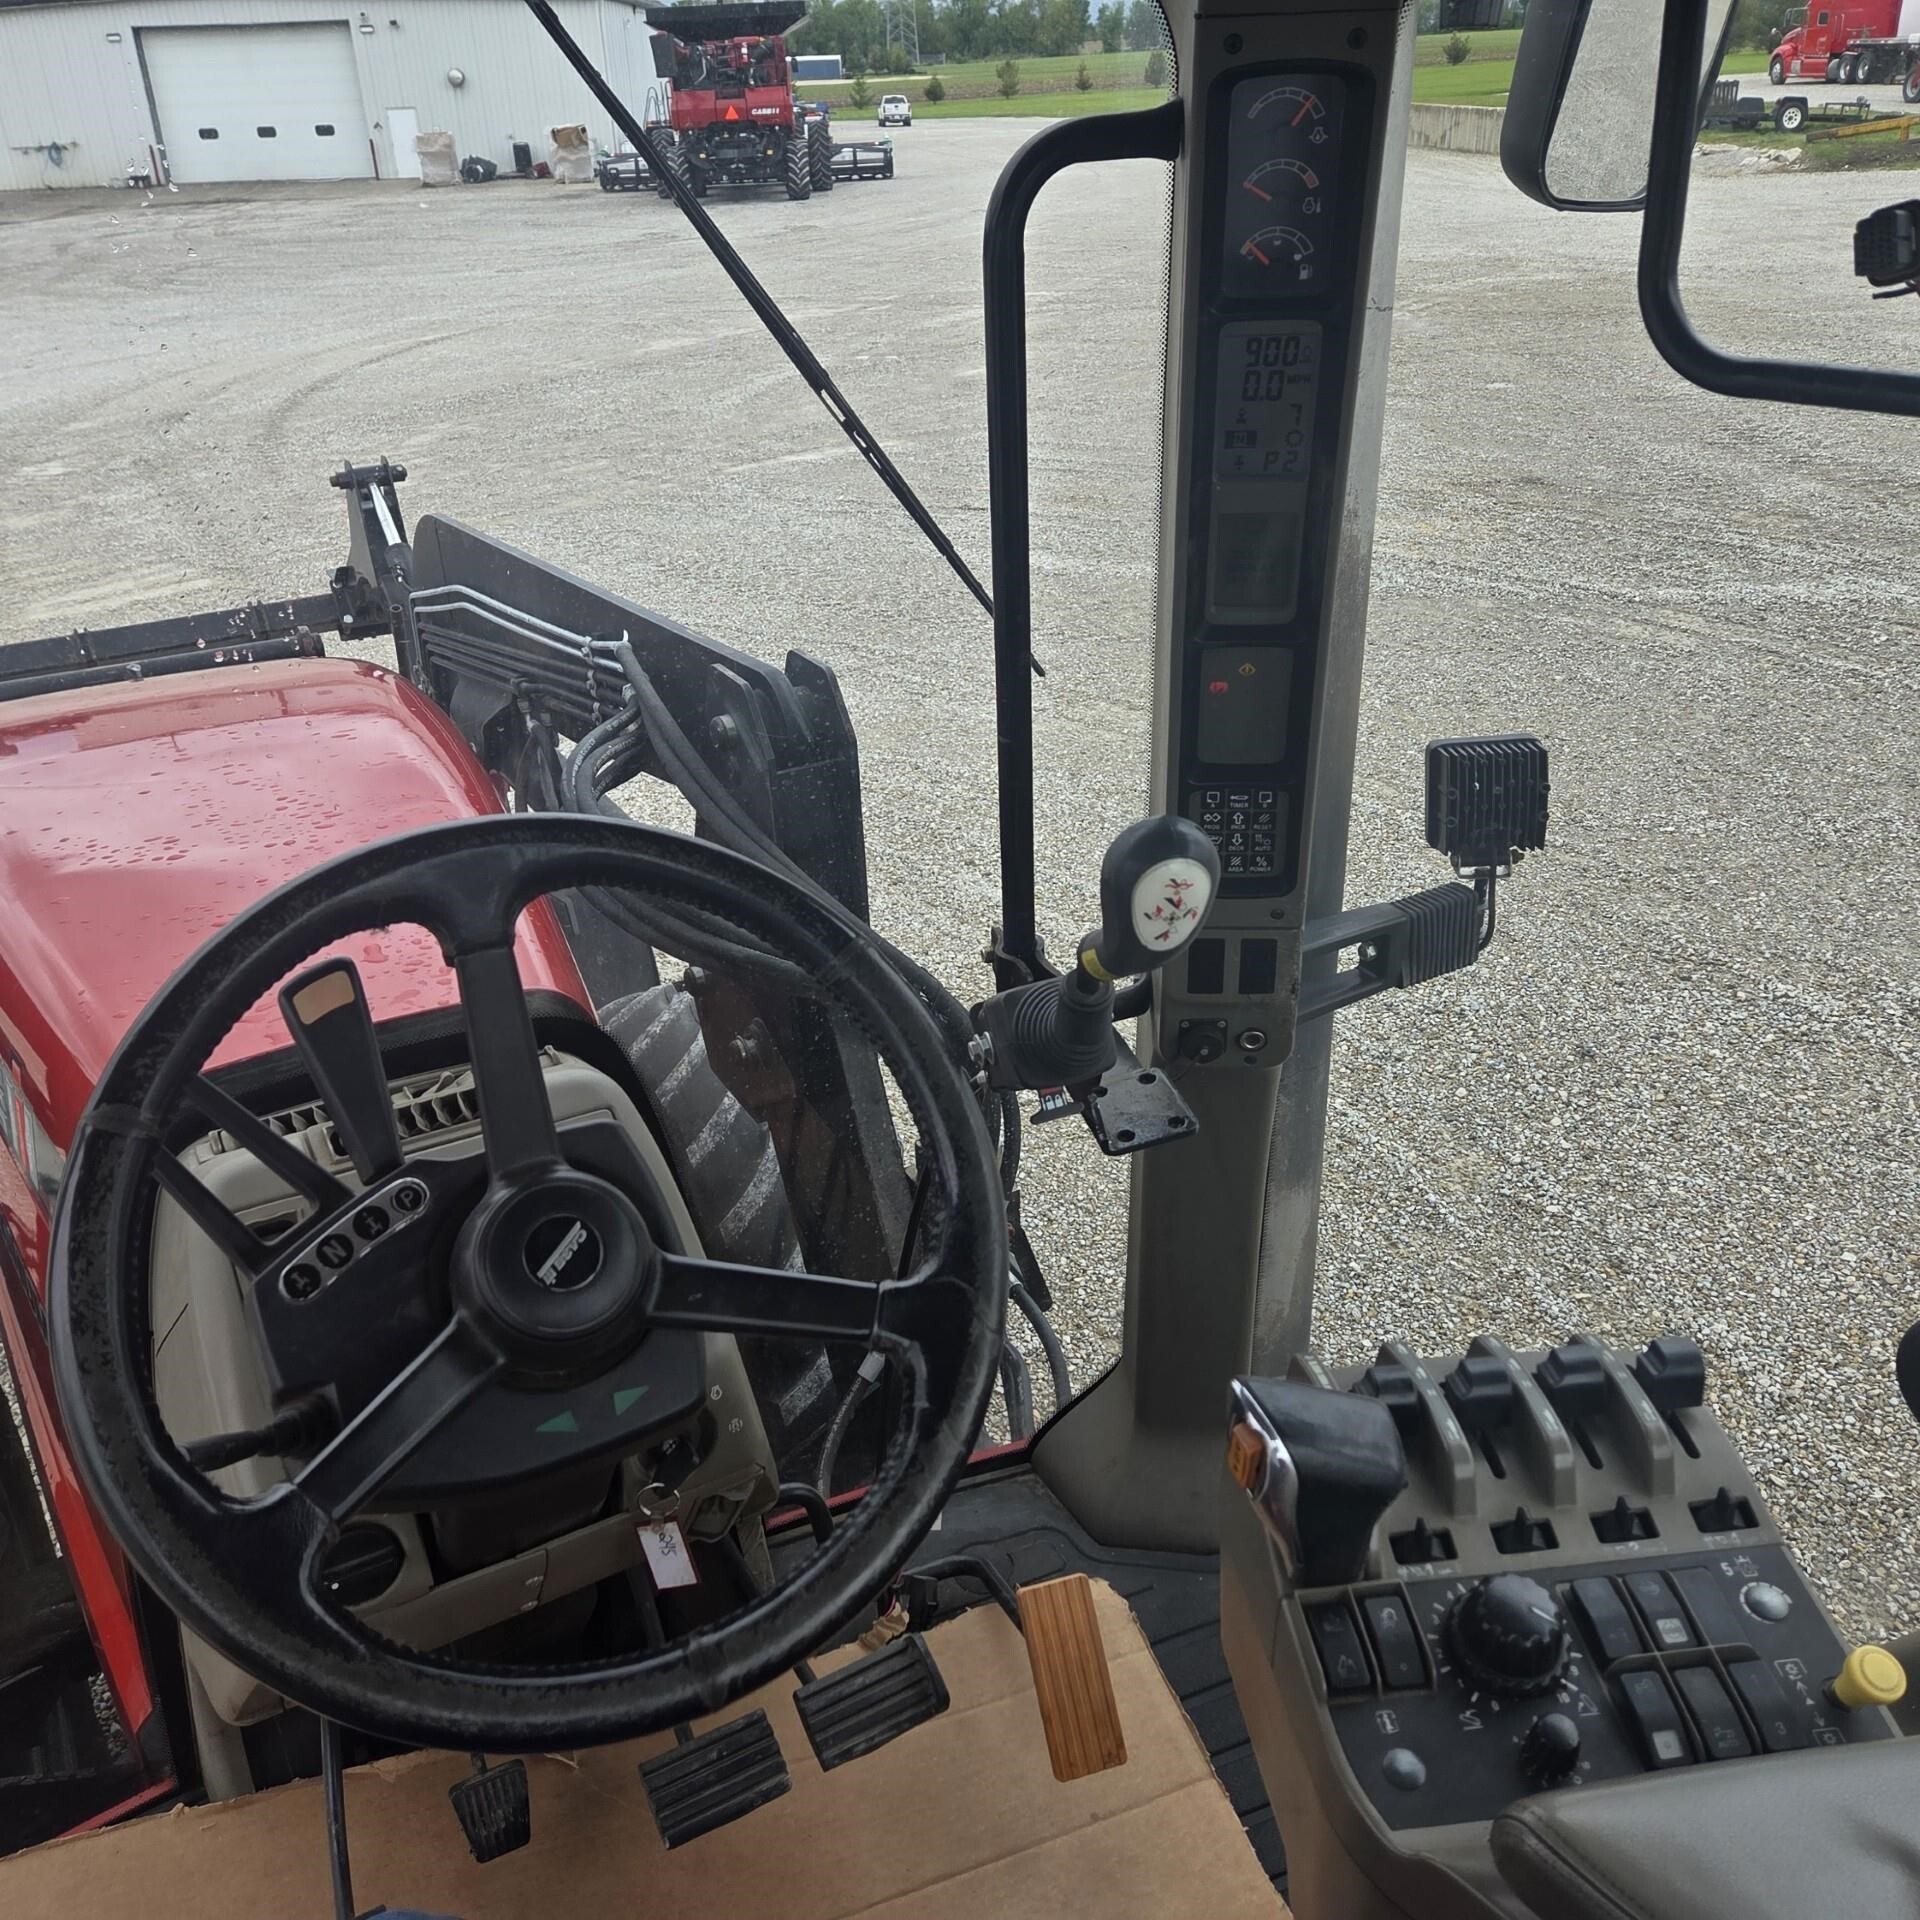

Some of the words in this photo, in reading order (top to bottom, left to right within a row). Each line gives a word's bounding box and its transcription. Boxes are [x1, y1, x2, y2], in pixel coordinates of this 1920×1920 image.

[1245, 335, 1301, 367] 900
[1241, 370, 1285, 402] 0.0
[400, 1191, 413, 1207] P
[322, 1241, 347, 1264] N
[1720, 1561, 1734, 1576] 5
[1775, 1722, 1787, 1736] 3
